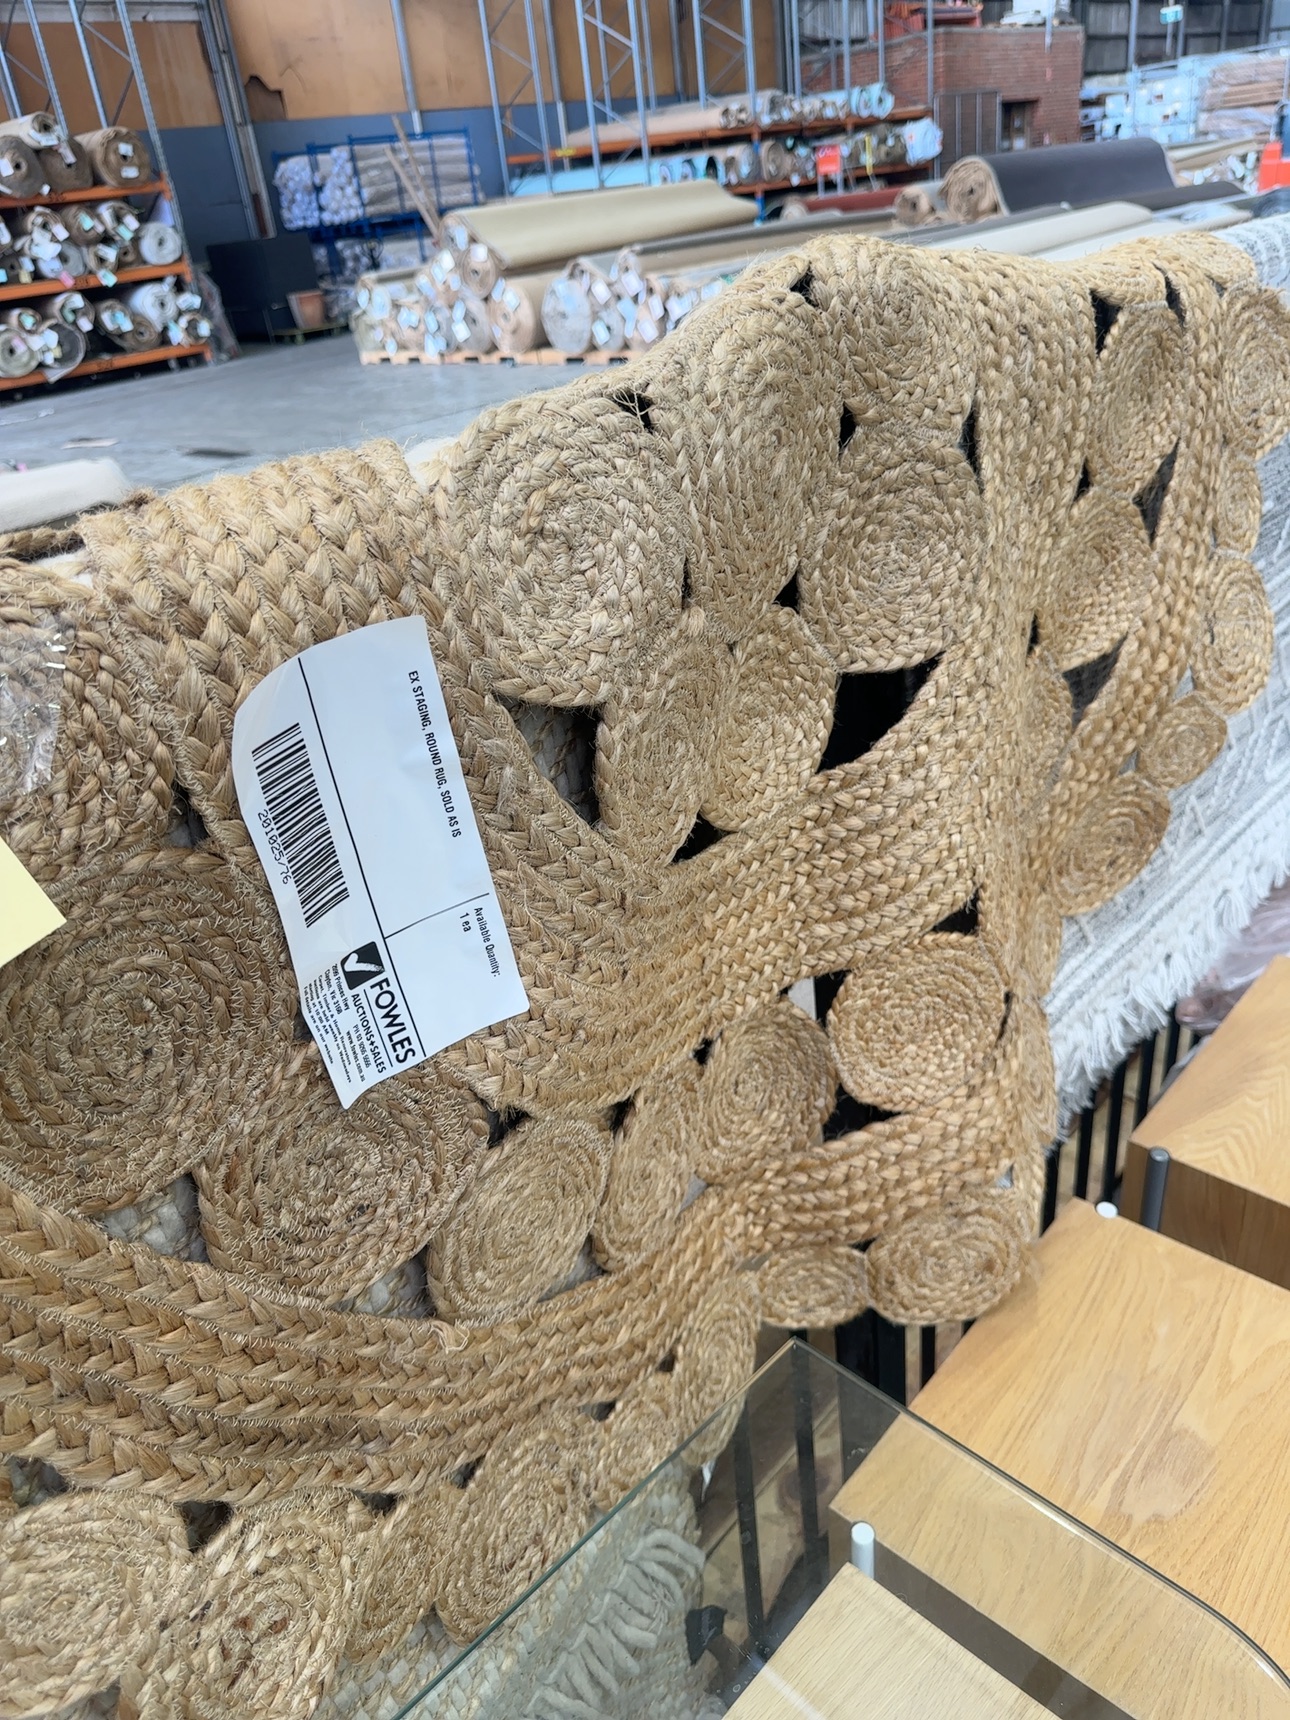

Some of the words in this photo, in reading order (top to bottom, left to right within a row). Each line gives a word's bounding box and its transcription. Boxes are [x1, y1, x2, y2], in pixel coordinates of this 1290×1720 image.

[407, 670, 421, 684] EX
[411, 685, 432, 731] STAGING,
[424, 731, 443, 767] ROUND
[433, 767, 448, 790] RUG,
[439, 789, 455, 814] SOLD
[446, 814, 459, 828] AS
[450, 828, 462, 839] IS
[257, 808, 293, 885] 201025/76
[461, 920, 473, 933] ea
[473, 906, 493, 944] Available
[483, 943, 503, 978] Quantity:
[334, 976, 347, 998] Princes
[341, 997, 351, 1011] Hwy
[350, 993, 387, 1074] AUCTIONS+SALES
[352, 1023, 361, 1035] PH
[369, 977, 417, 1065] FOWLES
